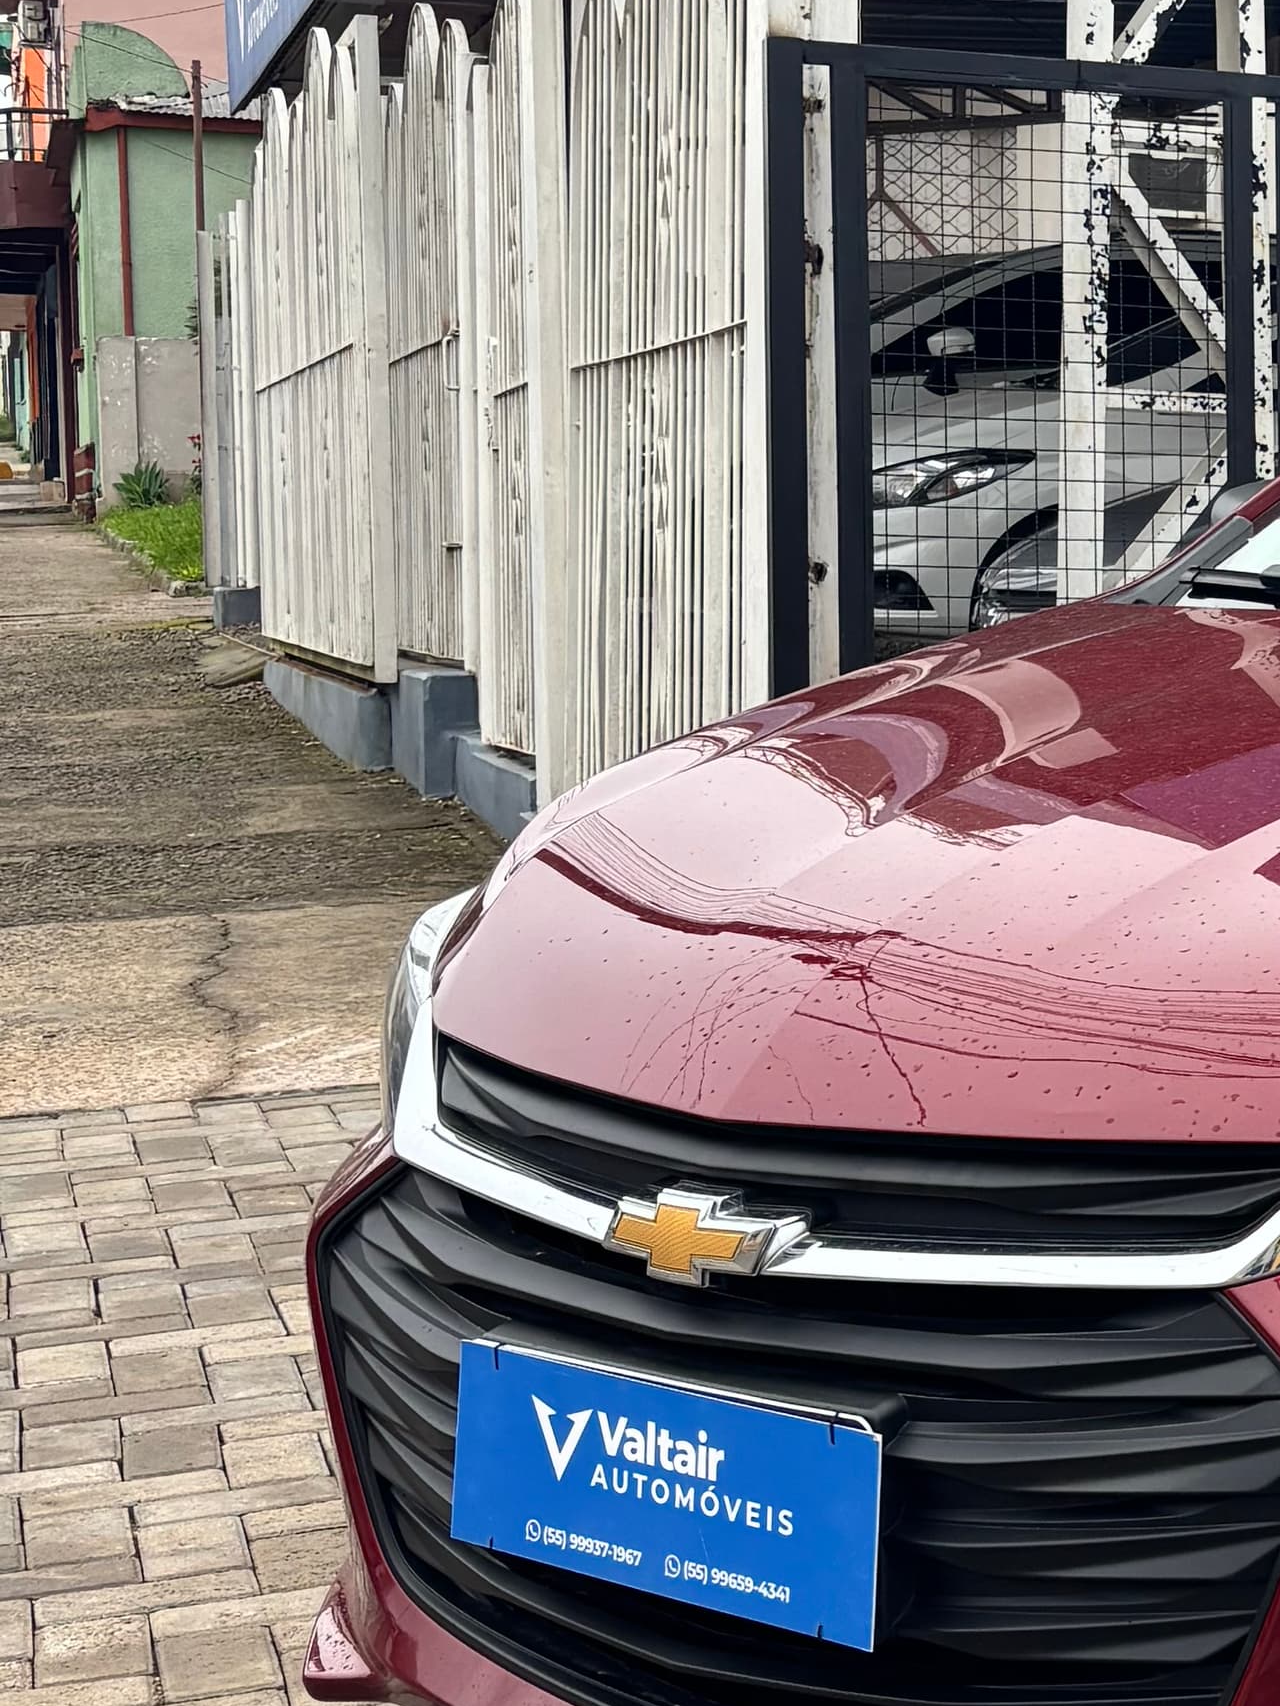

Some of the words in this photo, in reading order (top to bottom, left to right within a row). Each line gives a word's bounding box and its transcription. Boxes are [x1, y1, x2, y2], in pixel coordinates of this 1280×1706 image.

[597, 1411, 726, 1483] Valtair
[590, 1464, 794, 1537] AUTOMÓVEIS
[543, 1525, 567, 1550] (55)
[569, 1533, 643, 1567] 99937-1967
[683, 1560, 709, 1585] (55)
[711, 1568, 791, 1603] 99659-4341
